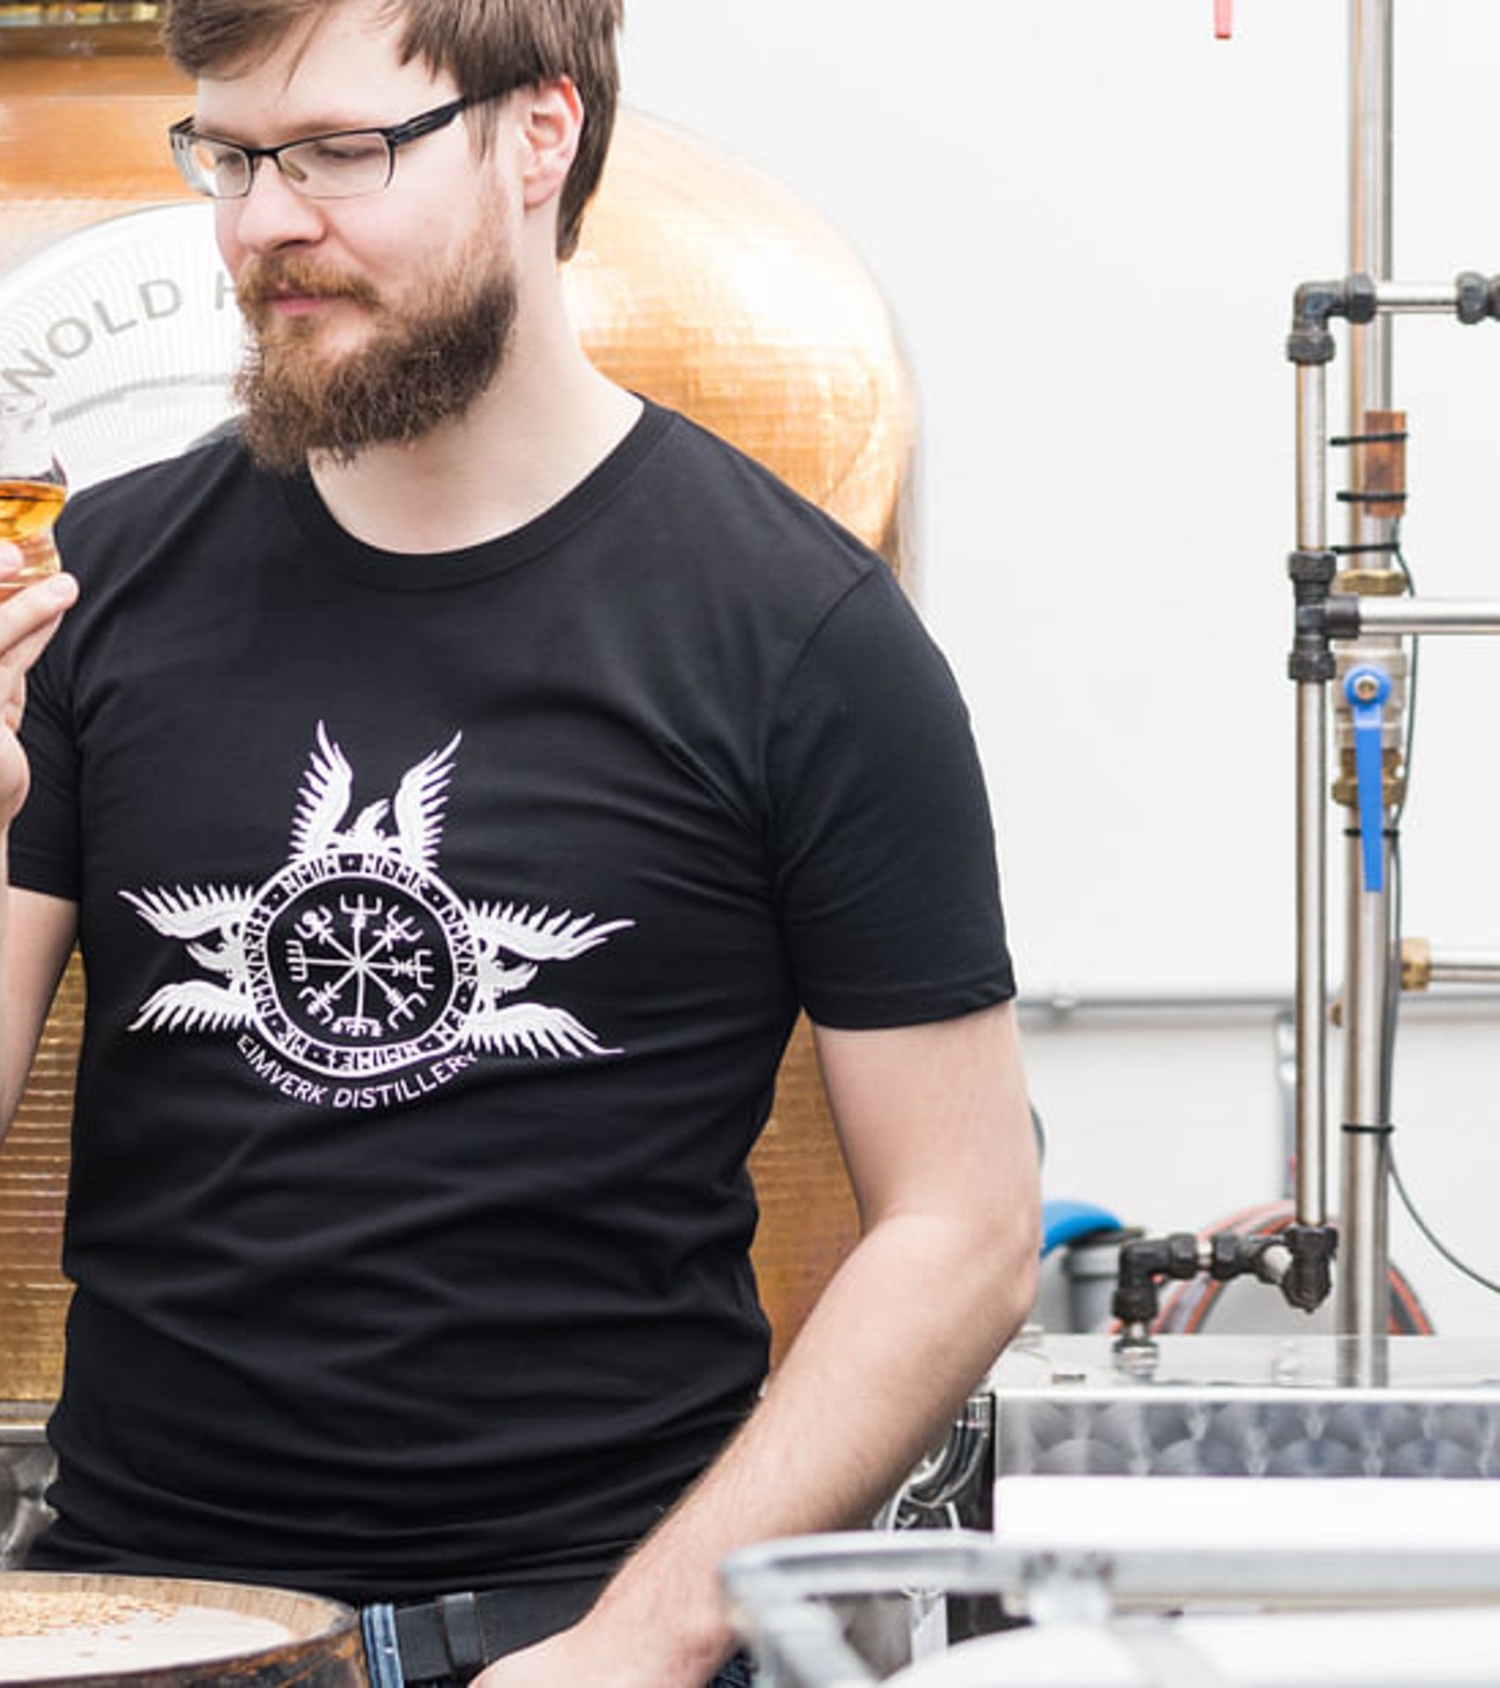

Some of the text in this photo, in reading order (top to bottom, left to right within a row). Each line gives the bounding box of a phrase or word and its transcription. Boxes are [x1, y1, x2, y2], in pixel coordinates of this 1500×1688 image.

[0, 277, 182, 397] NOLD
[236, 1033, 479, 1109] EIMVERK DISTILLERY
